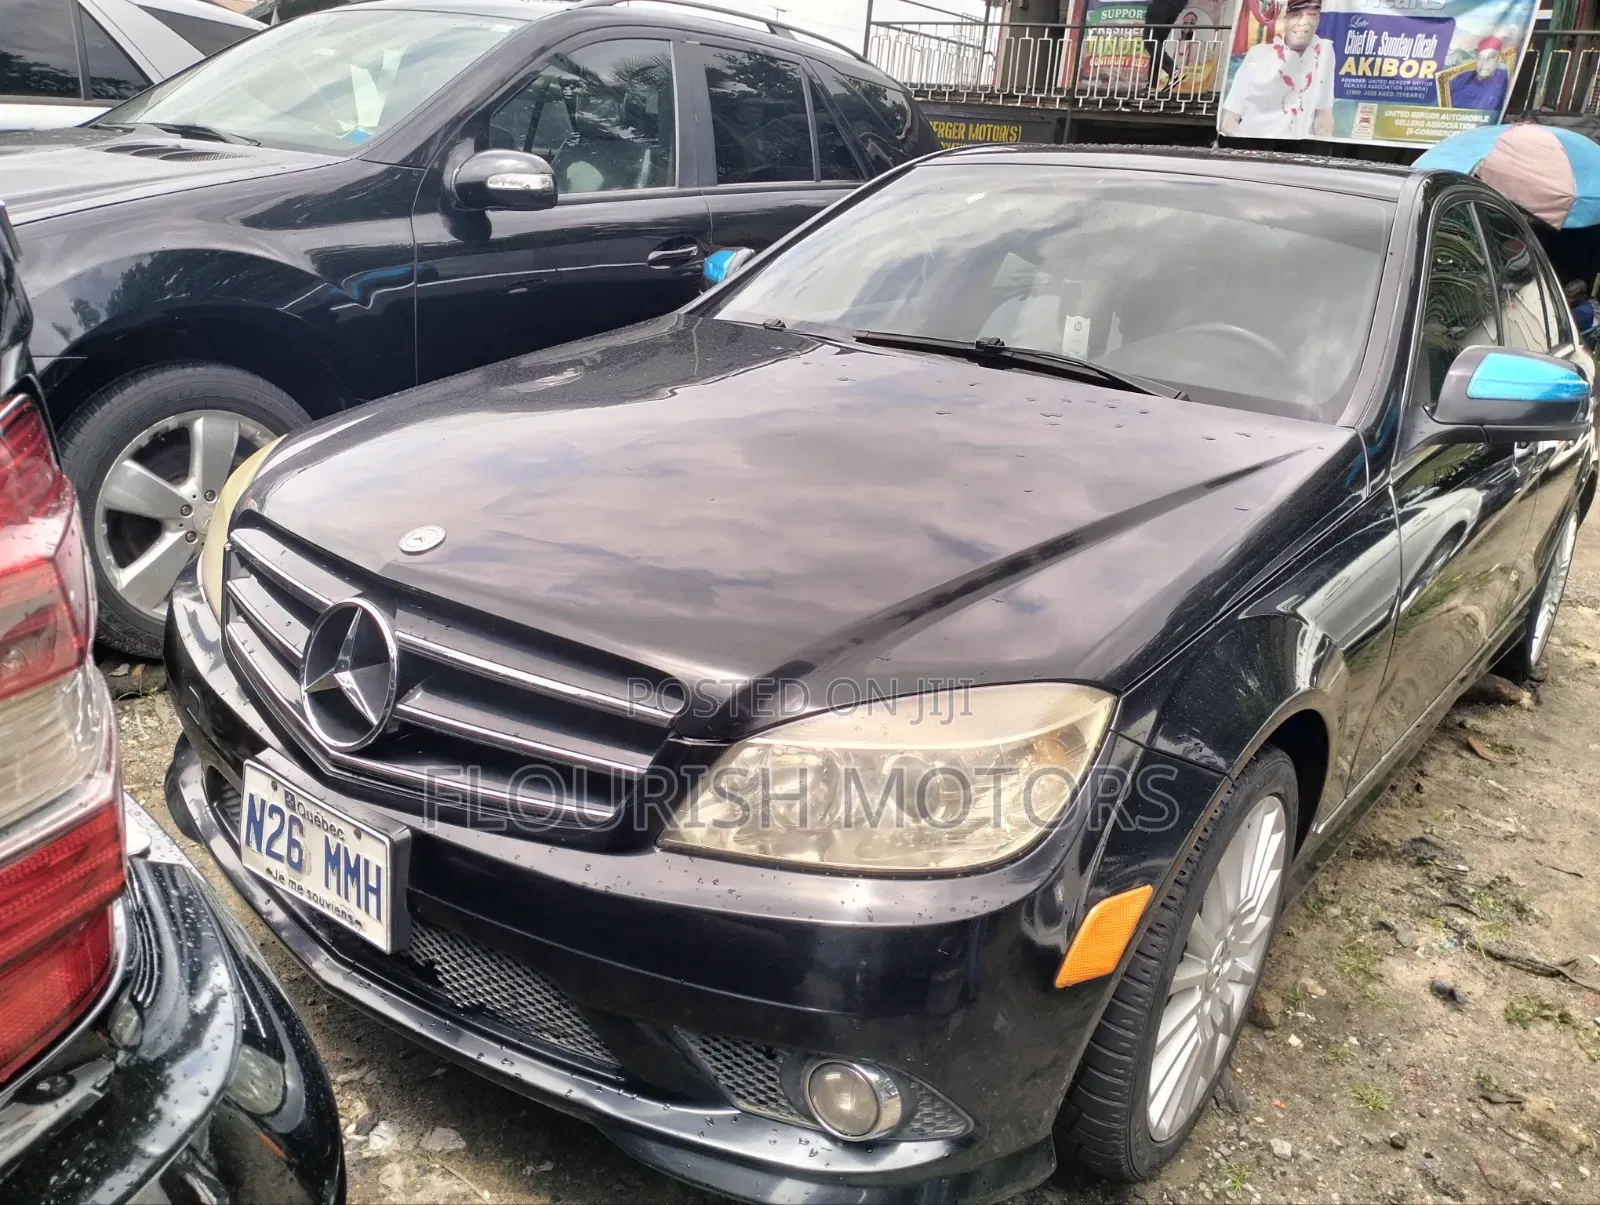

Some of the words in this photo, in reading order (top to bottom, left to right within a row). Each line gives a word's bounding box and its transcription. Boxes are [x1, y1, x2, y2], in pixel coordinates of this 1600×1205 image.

[1101, 8, 1147, 20] SUPPOR
[1087, 35, 1147, 55] TINUB
[1344, 29, 1368, 55] Chief
[1365, 30, 1378, 55] Dr.
[1377, 31, 1414, 60] Sunday
[1411, 33, 1438, 58] Okah
[1339, 56, 1438, 79] AKIBOR
[1388, 79, 1411, 87] BERGER
[1384, 110, 1410, 118] UNITED
[1410, 111, 1440, 120] BERGER
[1442, 114, 1490, 123] AUTOMOBILE
[1394, 119, 1425, 127] SELLERS
[1425, 121, 1476, 130] ASSOCIATION
[929, 121, 966, 140] ERGER
[968, 123, 1022, 142] MOTOR(S)
[297, 802, 346, 841] Québec
[244, 791, 304, 872] N26
[324, 833, 382, 922] MMH
[272, 869, 285, 884] Je
[288, 878, 304, 896] me
[307, 891, 353, 925] souviens
